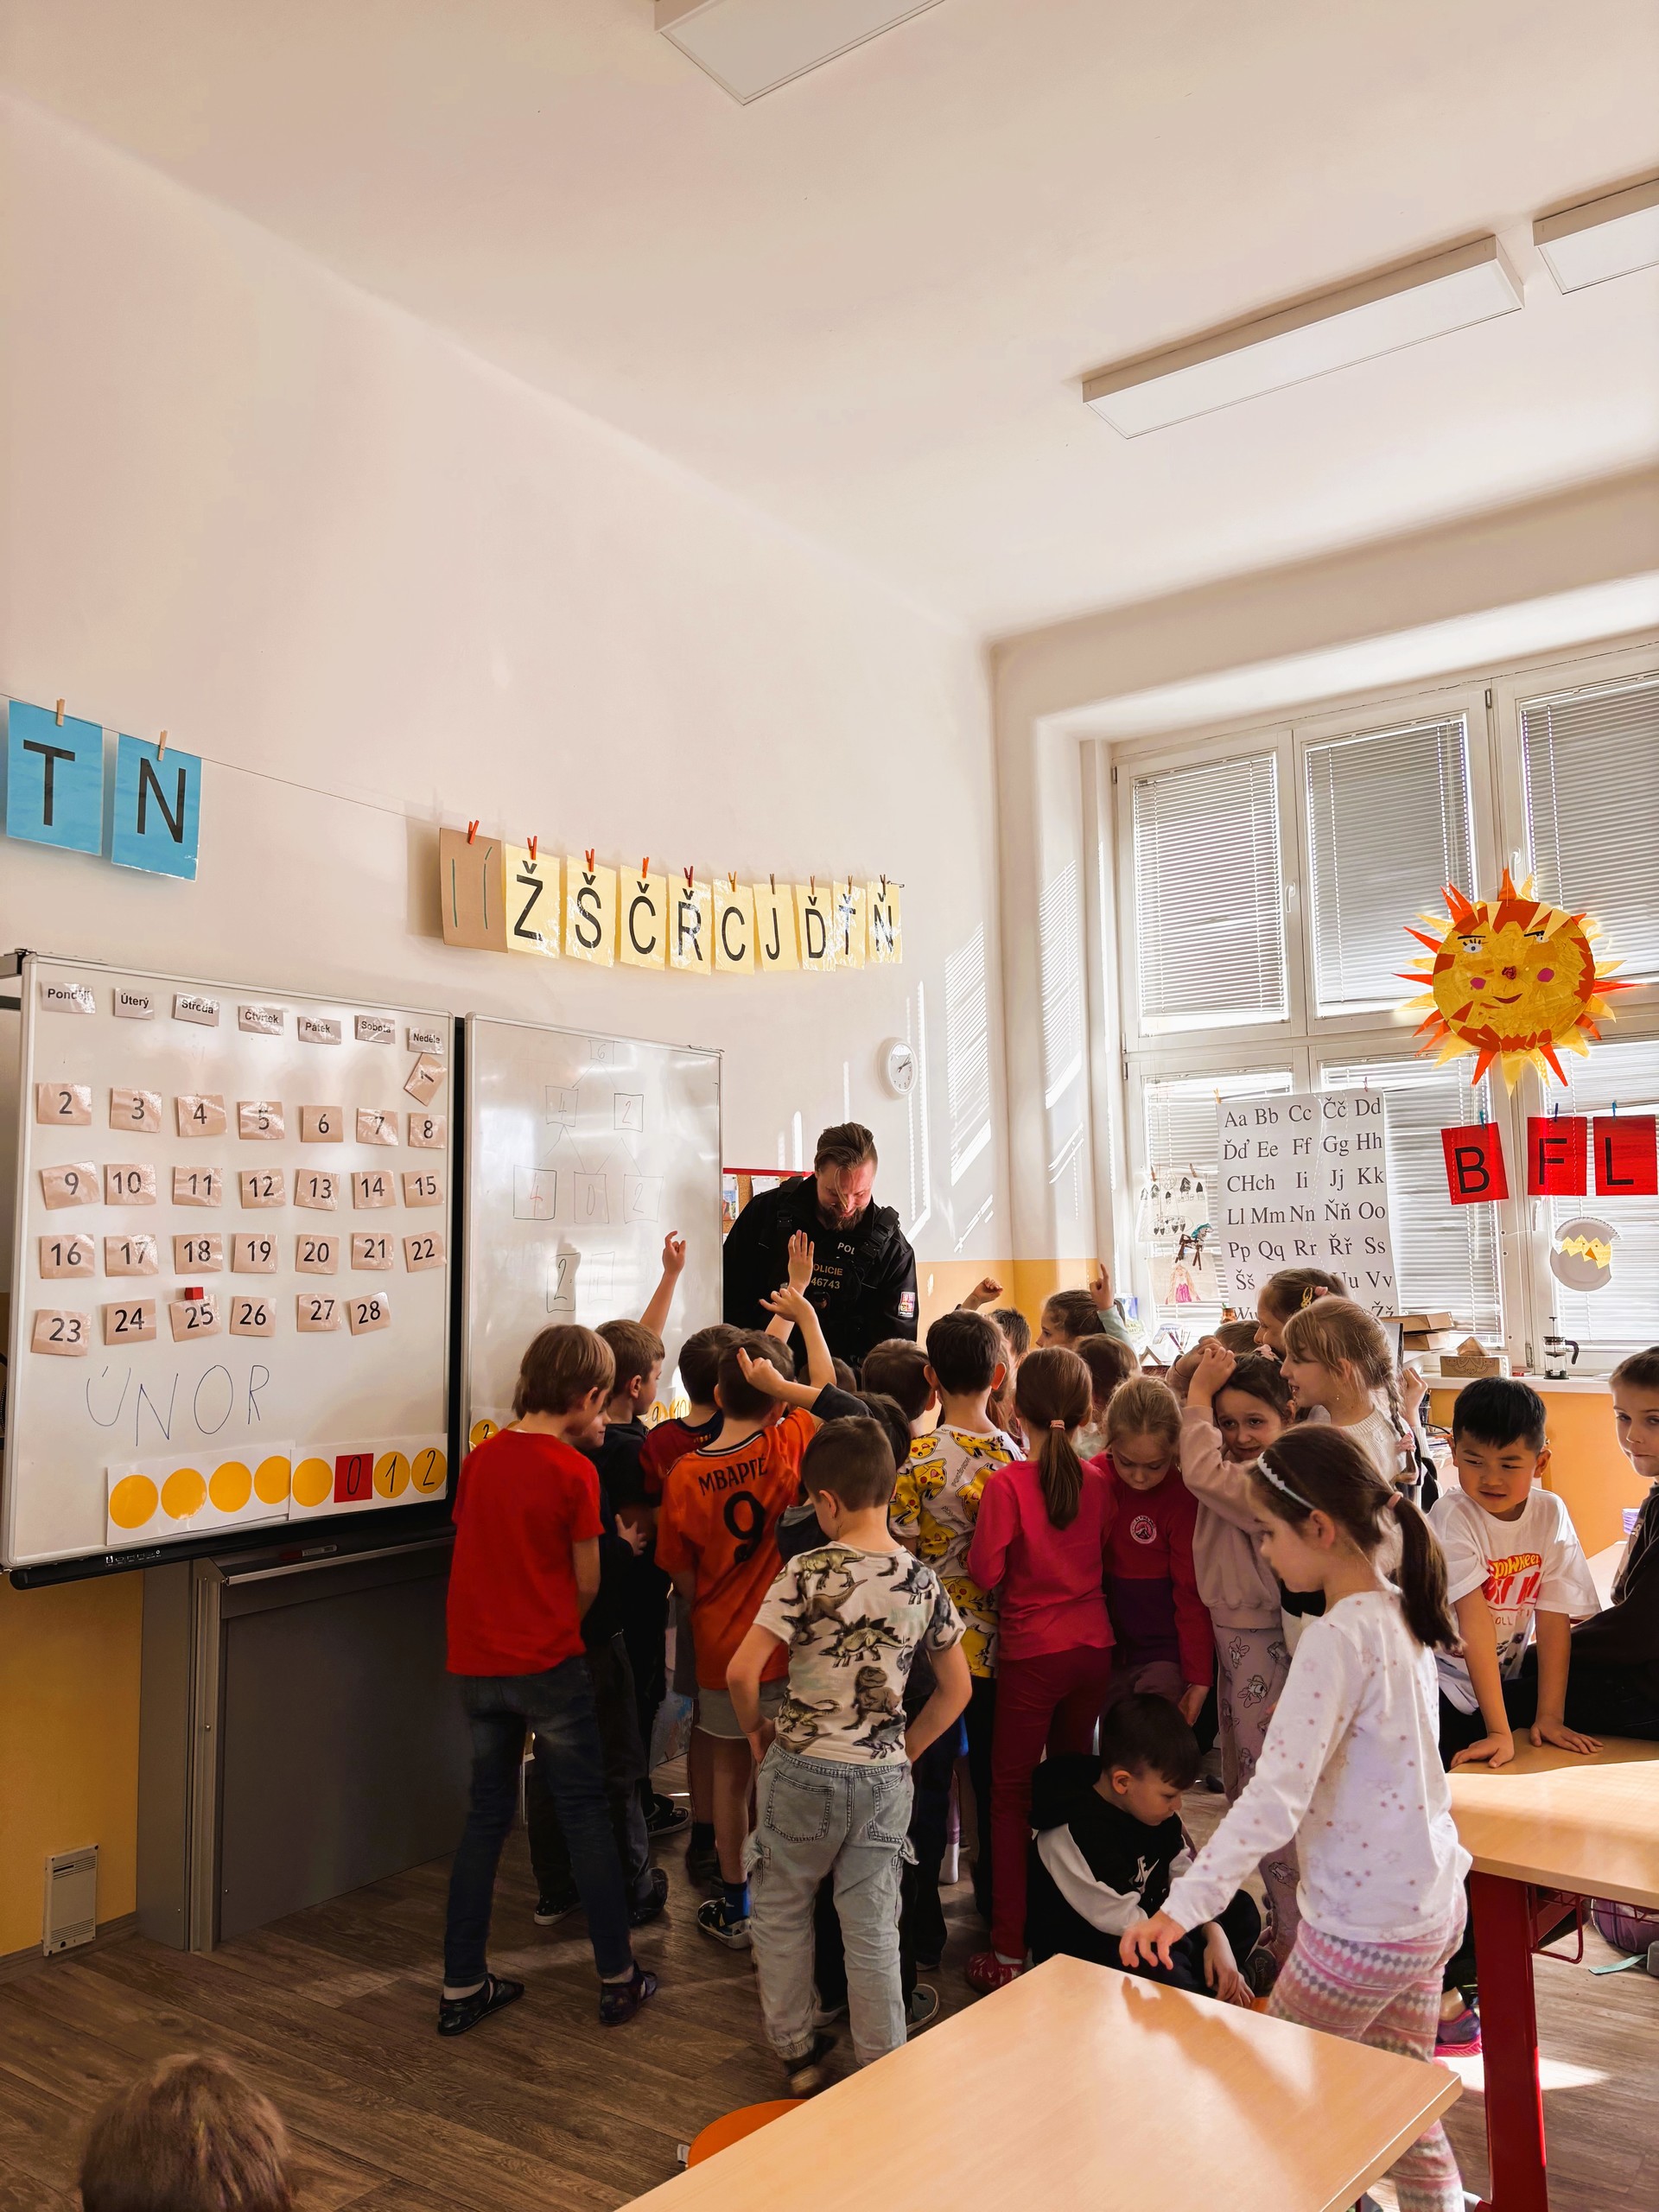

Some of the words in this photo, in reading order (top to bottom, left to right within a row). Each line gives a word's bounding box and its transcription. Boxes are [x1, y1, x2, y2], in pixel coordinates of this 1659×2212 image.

[23, 740, 75, 826] T
[137, 758, 186, 844] N
[514, 860, 543, 941] Ž
[575, 872, 602, 949] Š
[629, 881, 657, 954] Č
[678, 889, 703, 961] Ř
[721, 907, 746, 962] C
[766, 907, 780, 960] J
[804, 895, 826, 958] Ď
[874, 892, 893, 952] Ň
[120, 992, 149, 1009] Úterý
[413, 1033, 441, 1044] Neděle
[598, 1043, 606, 1059] 6
[59, 1091, 73, 1114] 2
[132, 1097, 145, 1120] 3
[194, 1103, 207, 1125] 4
[258, 1109, 270, 1130] 5
[318, 1115, 329, 1134] 6
[374, 1116, 385, 1135] 7
[423, 1120, 433, 1139] 8
[1224, 1112, 1248, 1128] Aa
[1255, 1108, 1279, 1125] Bb
[1289, 1105, 1313, 1122] Cc
[1323, 1097, 1346, 1119] Čč
[1355, 1098, 1382, 1117] Dd
[1224, 1140, 1249, 1160] Ďď
[1257, 1141, 1279, 1158] Ee
[1293, 1138, 1313, 1154] Ff
[1323, 1135, 1349, 1156] Gg
[1357, 1132, 1382, 1151] Hh
[1227, 1174, 1275, 1192] CHch
[1296, 1172, 1308, 1189] Ii
[1330, 1169, 1344, 1191] Jj
[1357, 1166, 1384, 1185] Kk
[1454, 1147, 1490, 1193] B
[1539, 1138, 1567, 1185] F
[1605, 1137, 1634, 1185] L
[65, 1173, 79, 1195] 9
[112, 1172, 141, 1194] 10
[188, 1173, 212, 1196] 11
[249, 1176, 274, 1198] 12
[309, 1178, 332, 1199] 13
[360, 1177, 385, 1198] 14
[415, 1176, 436, 1196] 15
[1228, 1208, 1243, 1225] Ll
[1250, 1207, 1285, 1224] Mm
[1289, 1205, 1315, 1223] Nn
[1325, 1199, 1351, 1221] Ňň
[1358, 1202, 1385, 1219] Oo
[51, 1243, 81, 1266] 16
[120, 1243, 148, 1265] 17
[184, 1240, 211, 1262] 18
[247, 1240, 271, 1262] 19
[303, 1242, 329, 1262] 20
[365, 1239, 386, 1259] 21
[411, 1239, 435, 1260] 22
[1228, 1243, 1250, 1262] Pp
[1258, 1241, 1286, 1261] Qq
[1295, 1239, 1317, 1256] Rr
[1329, 1234, 1352, 1255] Řř
[1364, 1237, 1385, 1255] Ss
[813, 1263, 843, 1276] OLICIE
[1236, 1270, 1255, 1290] Šš
[1366, 1271, 1392, 1288] Vv
[49, 1318, 81, 1343] 23
[114, 1307, 144, 1332] 24
[185, 1303, 213, 1329] 25
[240, 1304, 266, 1325] 26
[310, 1300, 334, 1321] 27
[357, 1300, 381, 1324] 28
[86, 1365, 270, 1446] ÚNOR
[347, 1456, 362, 1495] 0
[385, 1455, 397, 1492] 1
[423, 1450, 435, 1485] 2
[724, 1491, 767, 1566] 9
